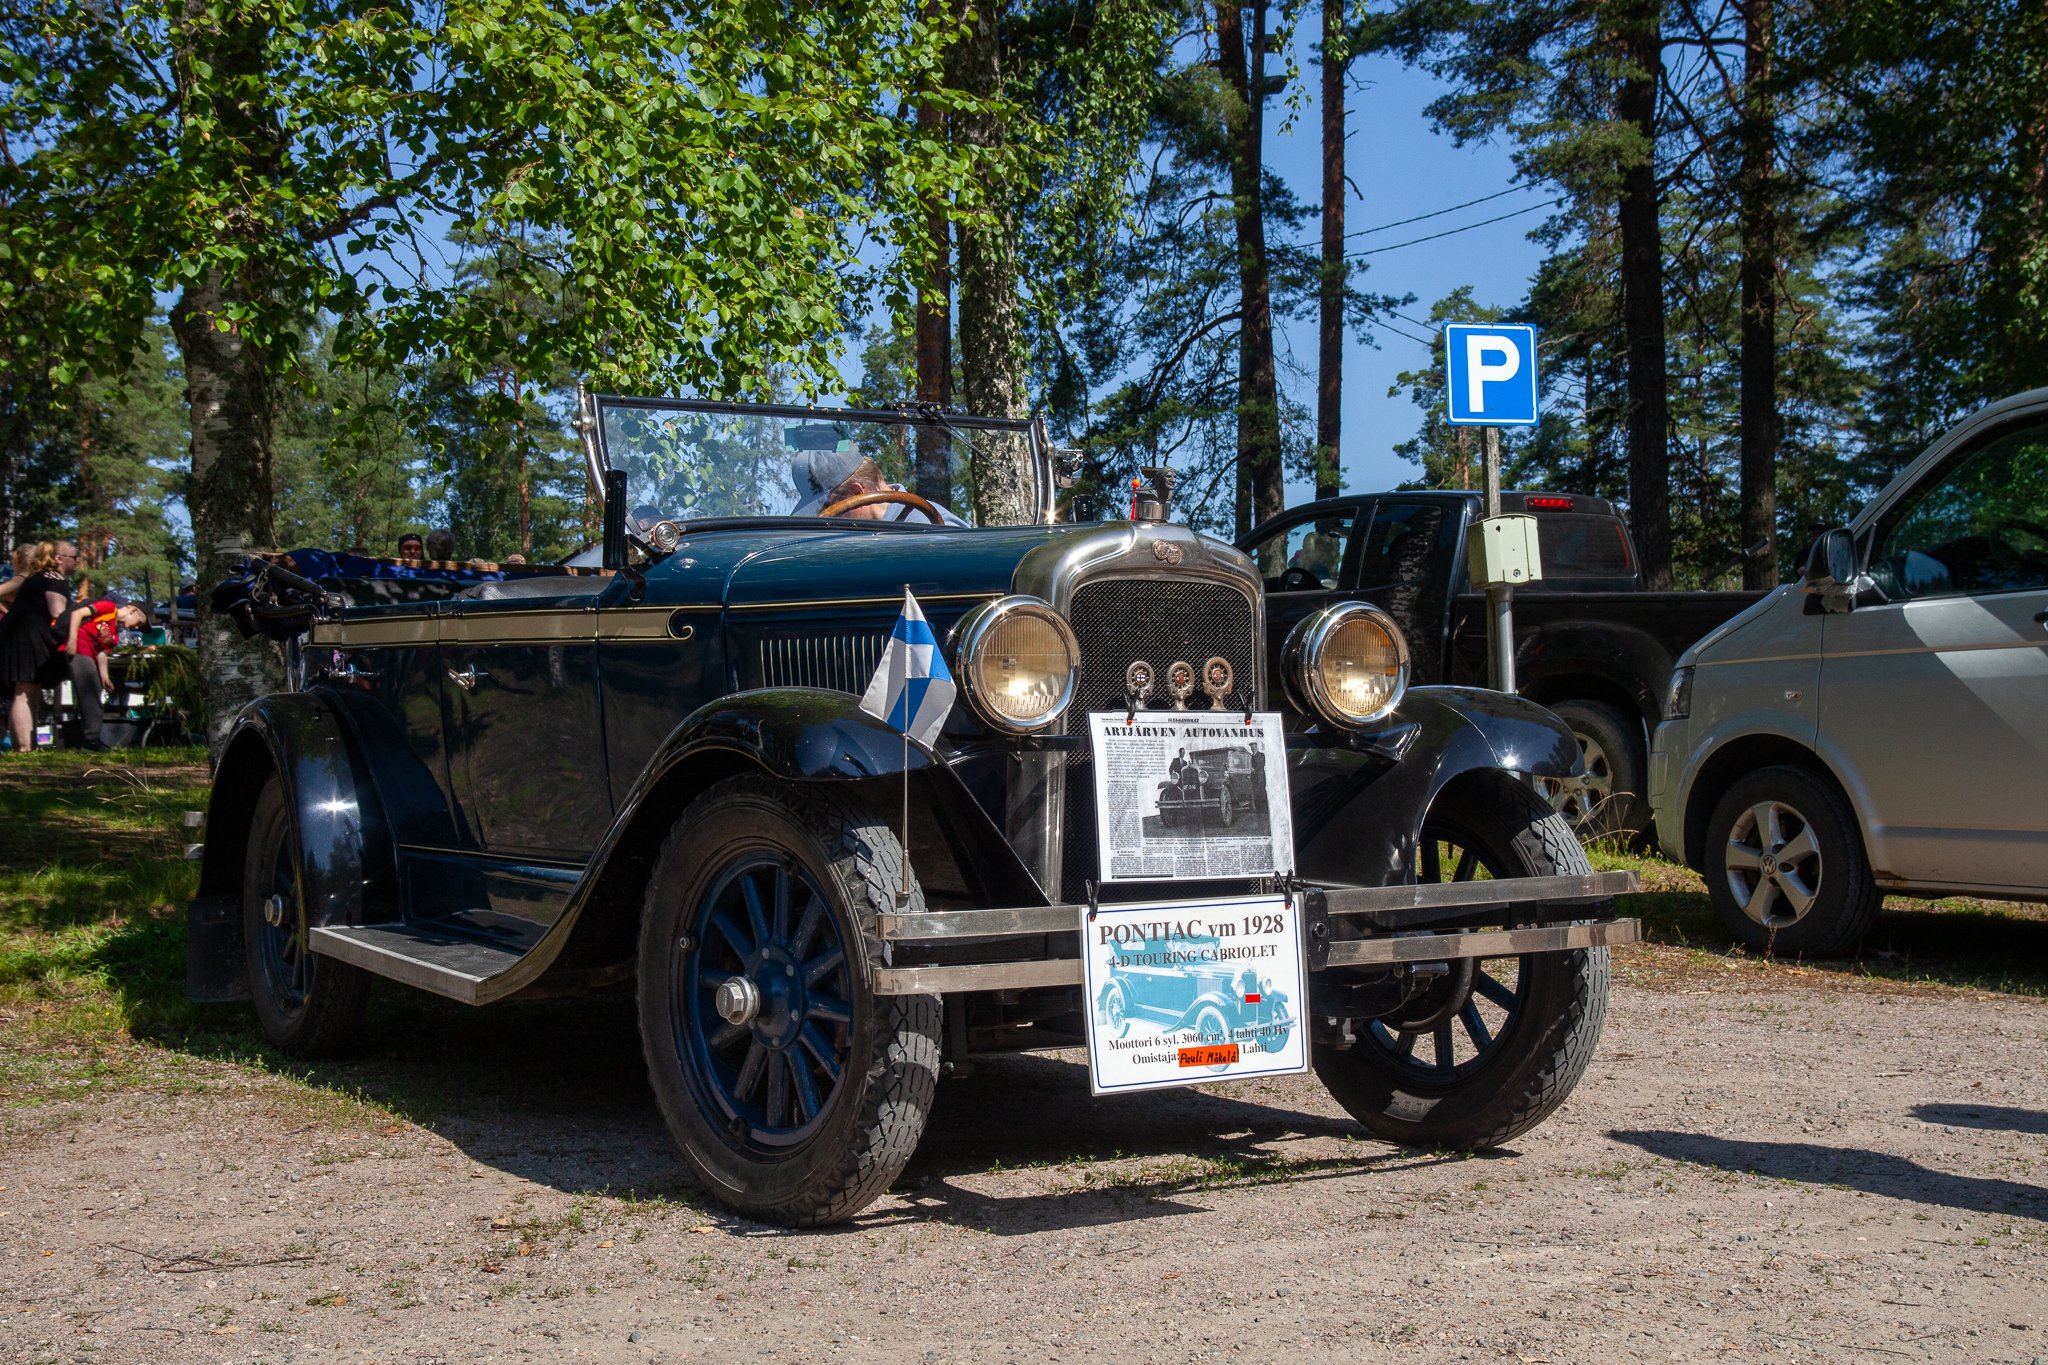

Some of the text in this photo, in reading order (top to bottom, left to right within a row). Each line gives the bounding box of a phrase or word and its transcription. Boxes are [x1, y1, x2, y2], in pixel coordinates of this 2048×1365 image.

[1466, 334, 1521, 413] P
[1103, 725, 1264, 738] ARTJÄRVEN AUTOVANHUS
[1099, 913, 1284, 945] PONTIAC vm 1928
[1108, 944, 1278, 968] 4-D TOURING CABRIOLET
[1108, 1036, 1153, 1051] Moottori
[1154, 1035, 1161, 1047] 6
[1162, 1034, 1179, 1047] syl.
[1182, 1032, 1203, 1045] 3060
[1227, 1029, 1234, 1040] 4
[1236, 1027, 1258, 1039] tahti
[1260, 1027, 1271, 1037] 40
[1273, 1025, 1289, 1036] Hv
[1180, 1051, 1203, 1064] Pauli
[1242, 1042, 1267, 1054] Lahti
[1132, 1051, 1180, 1065] Omistaja:
